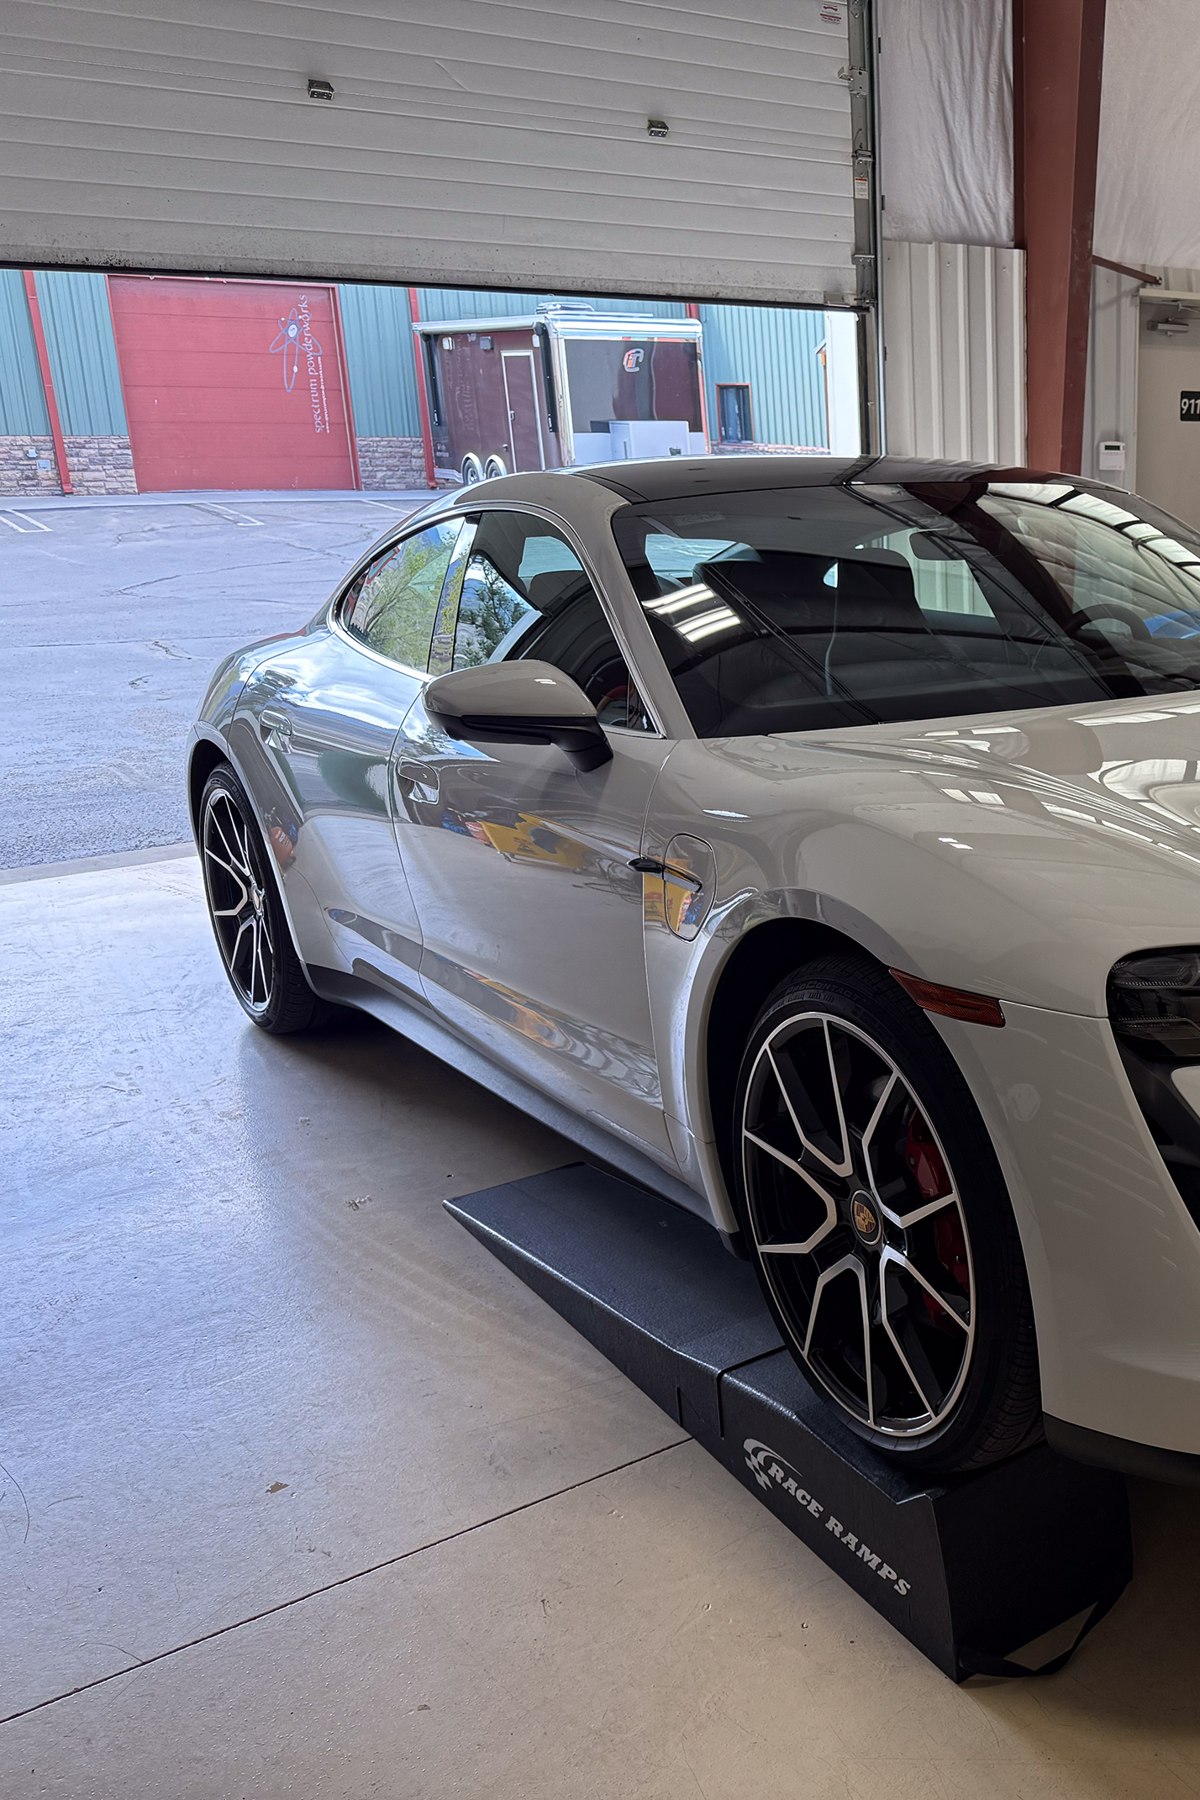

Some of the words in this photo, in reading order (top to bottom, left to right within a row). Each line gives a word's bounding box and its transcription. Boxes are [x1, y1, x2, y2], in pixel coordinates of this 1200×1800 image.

[298, 294, 319, 376] powderworks
[309, 379, 325, 433] spectrum
[1182, 399, 1200, 414] 911
[768, 1462, 824, 1518] RACE
[825, 1515, 911, 1596] RAMPS
